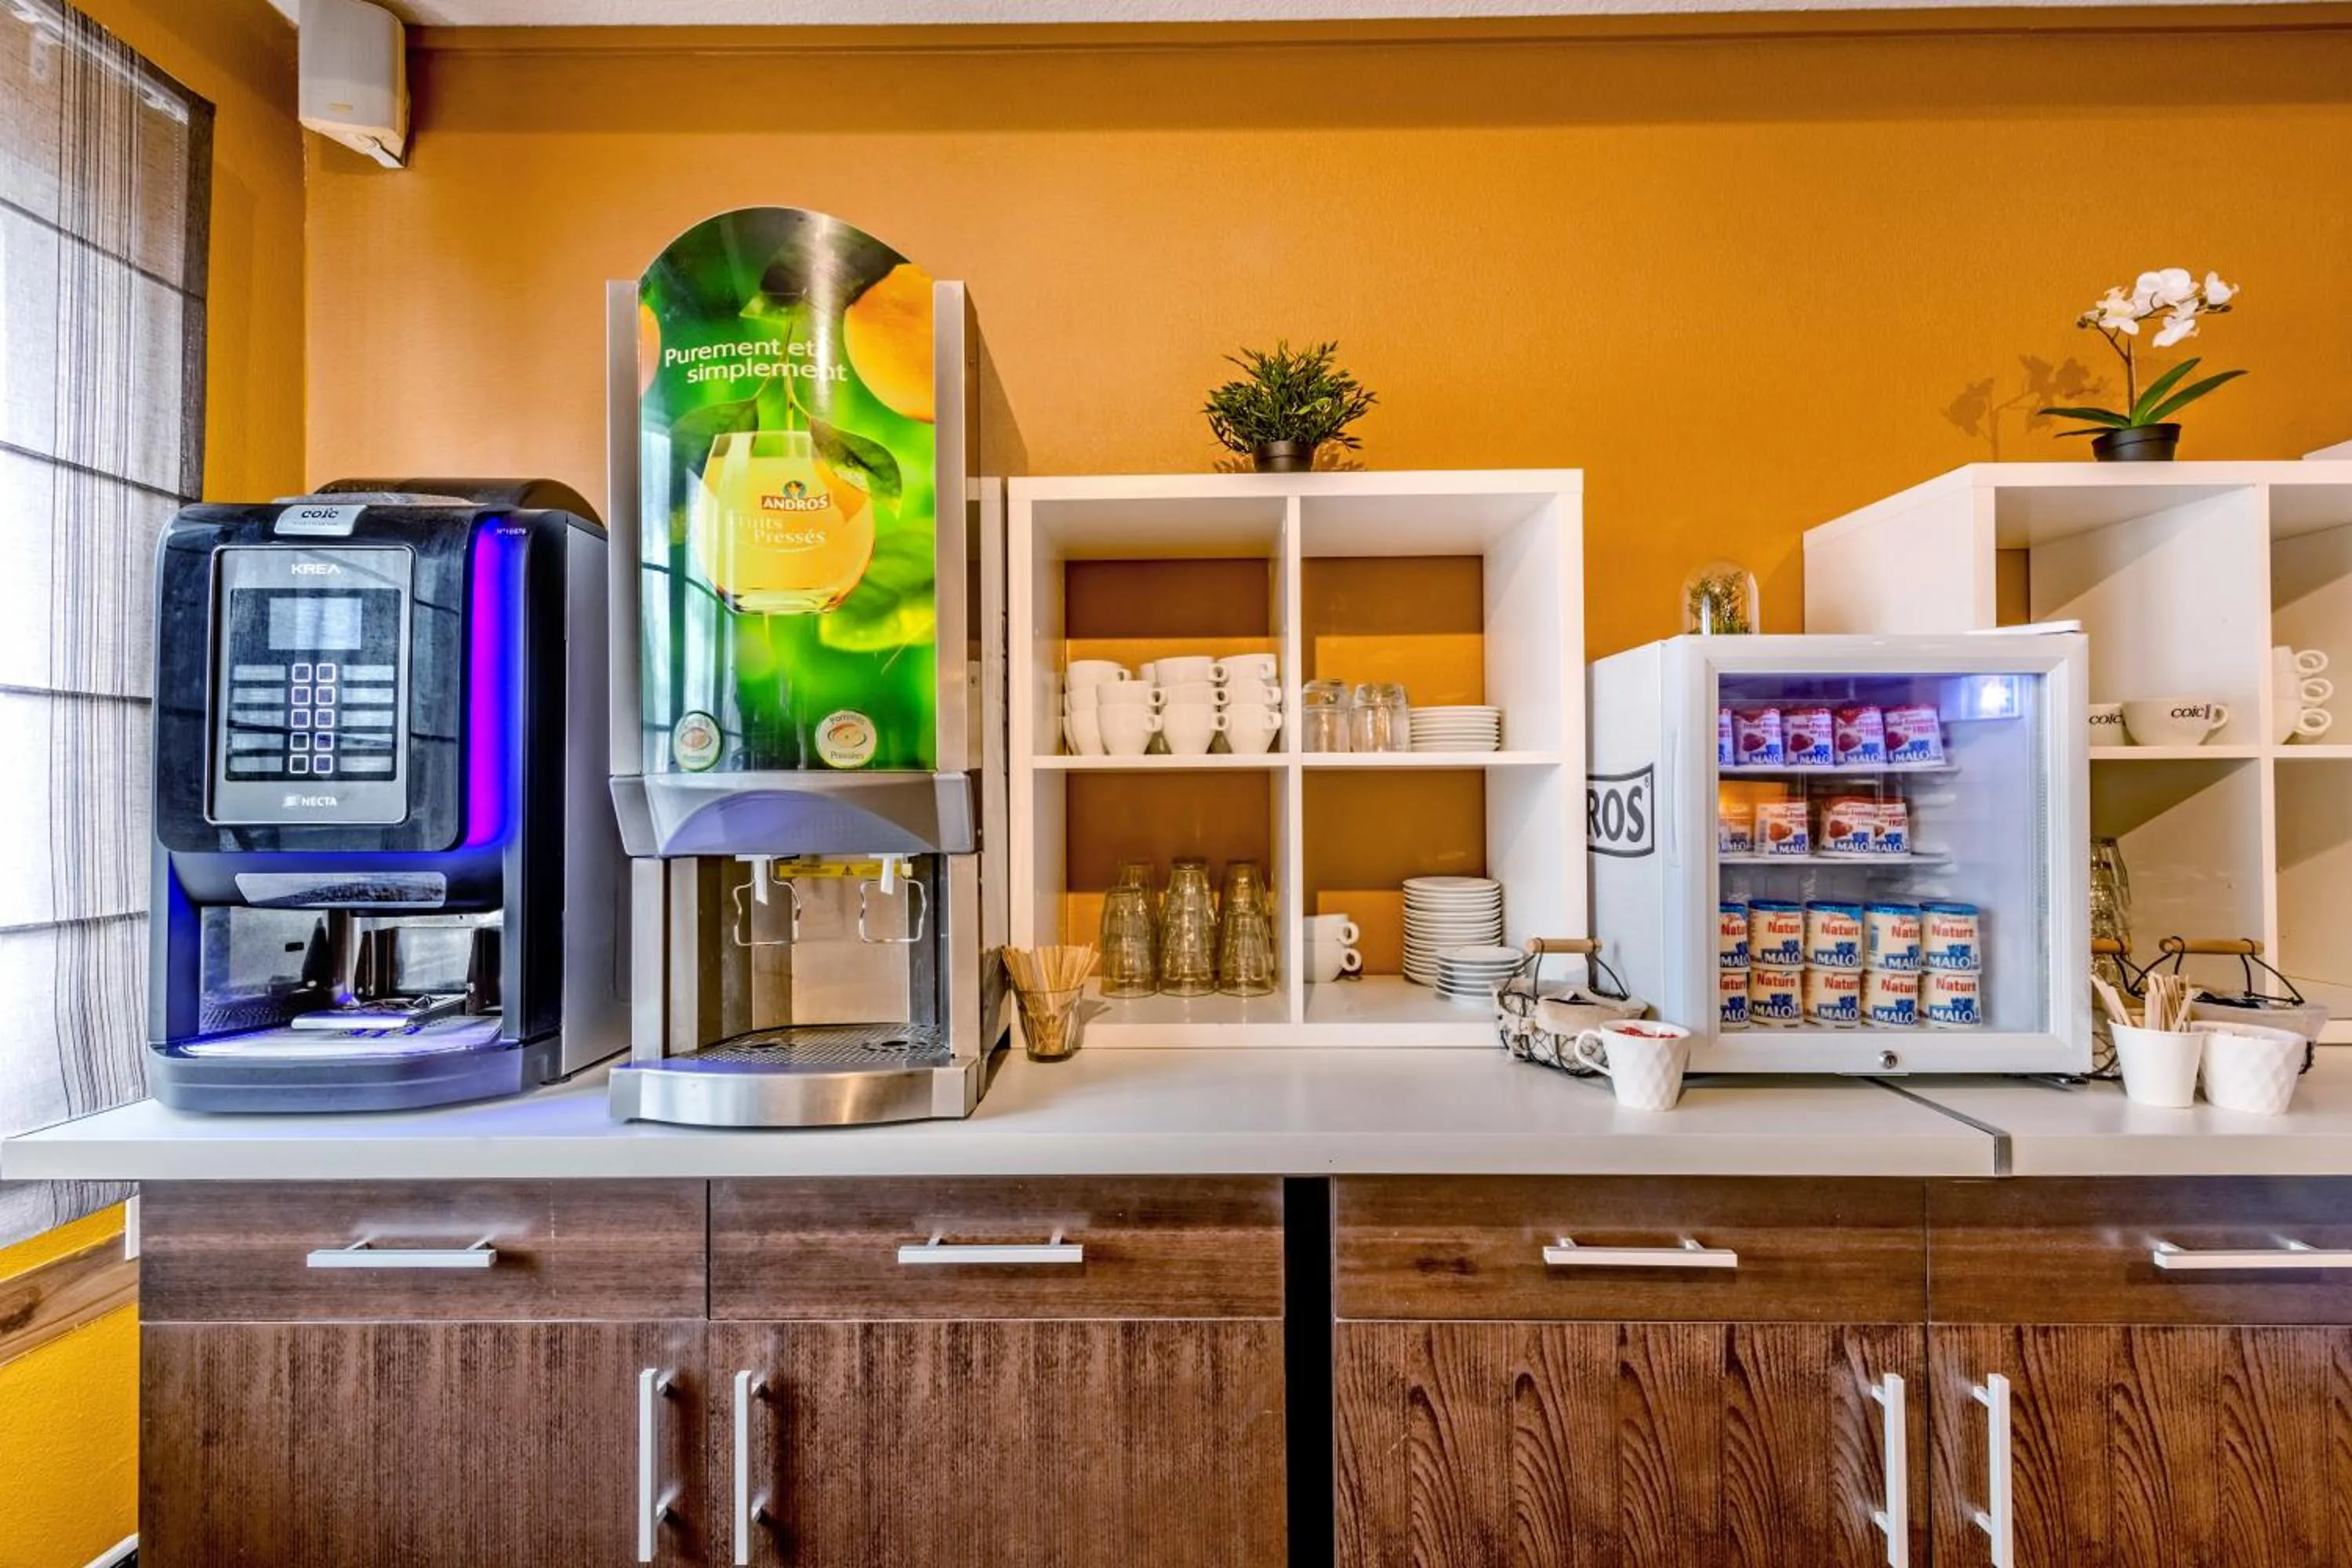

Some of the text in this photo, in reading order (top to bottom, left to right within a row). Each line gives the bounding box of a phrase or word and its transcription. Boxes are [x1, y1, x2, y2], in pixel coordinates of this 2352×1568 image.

[665, 338, 817, 368] Purement et
[687, 357, 848, 383] simplement
[763, 495, 829, 511] ANDROS
[291, 564, 341, 575] KREA
[302, 796, 337, 807] NECTA
[1763, 951, 1801, 964] MALO
[1816, 953, 1857, 967] MALO
[1929, 956, 1971, 969] MALO
[1757, 973, 1796, 987] Nature
[1754, 1004, 1793, 1018] MALO
[1819, 1007, 1857, 1021] MALO
[1875, 1008, 1914, 1023] MALO
[1932, 1007, 1973, 1023] MALO
